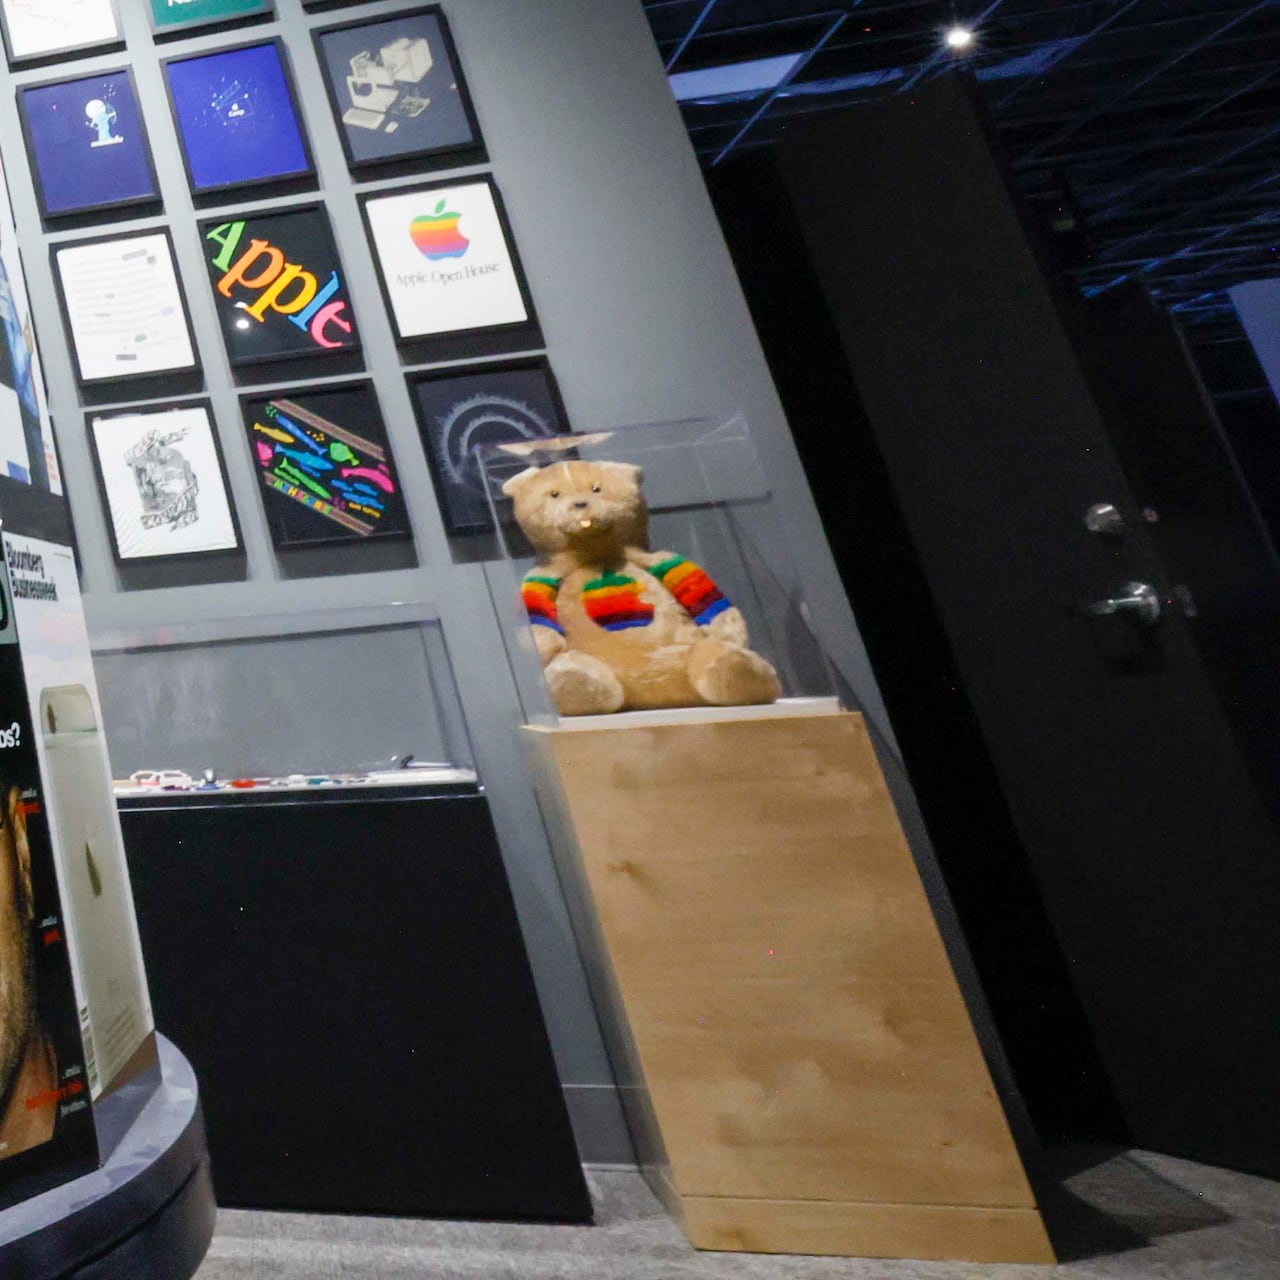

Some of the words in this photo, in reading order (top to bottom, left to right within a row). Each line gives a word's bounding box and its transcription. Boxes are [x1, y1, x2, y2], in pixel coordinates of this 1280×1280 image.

[206, 220, 352, 349] Apple
[394, 269, 427, 286] Apple
[431, 268, 463, 283] Open
[464, 261, 501, 278] House
